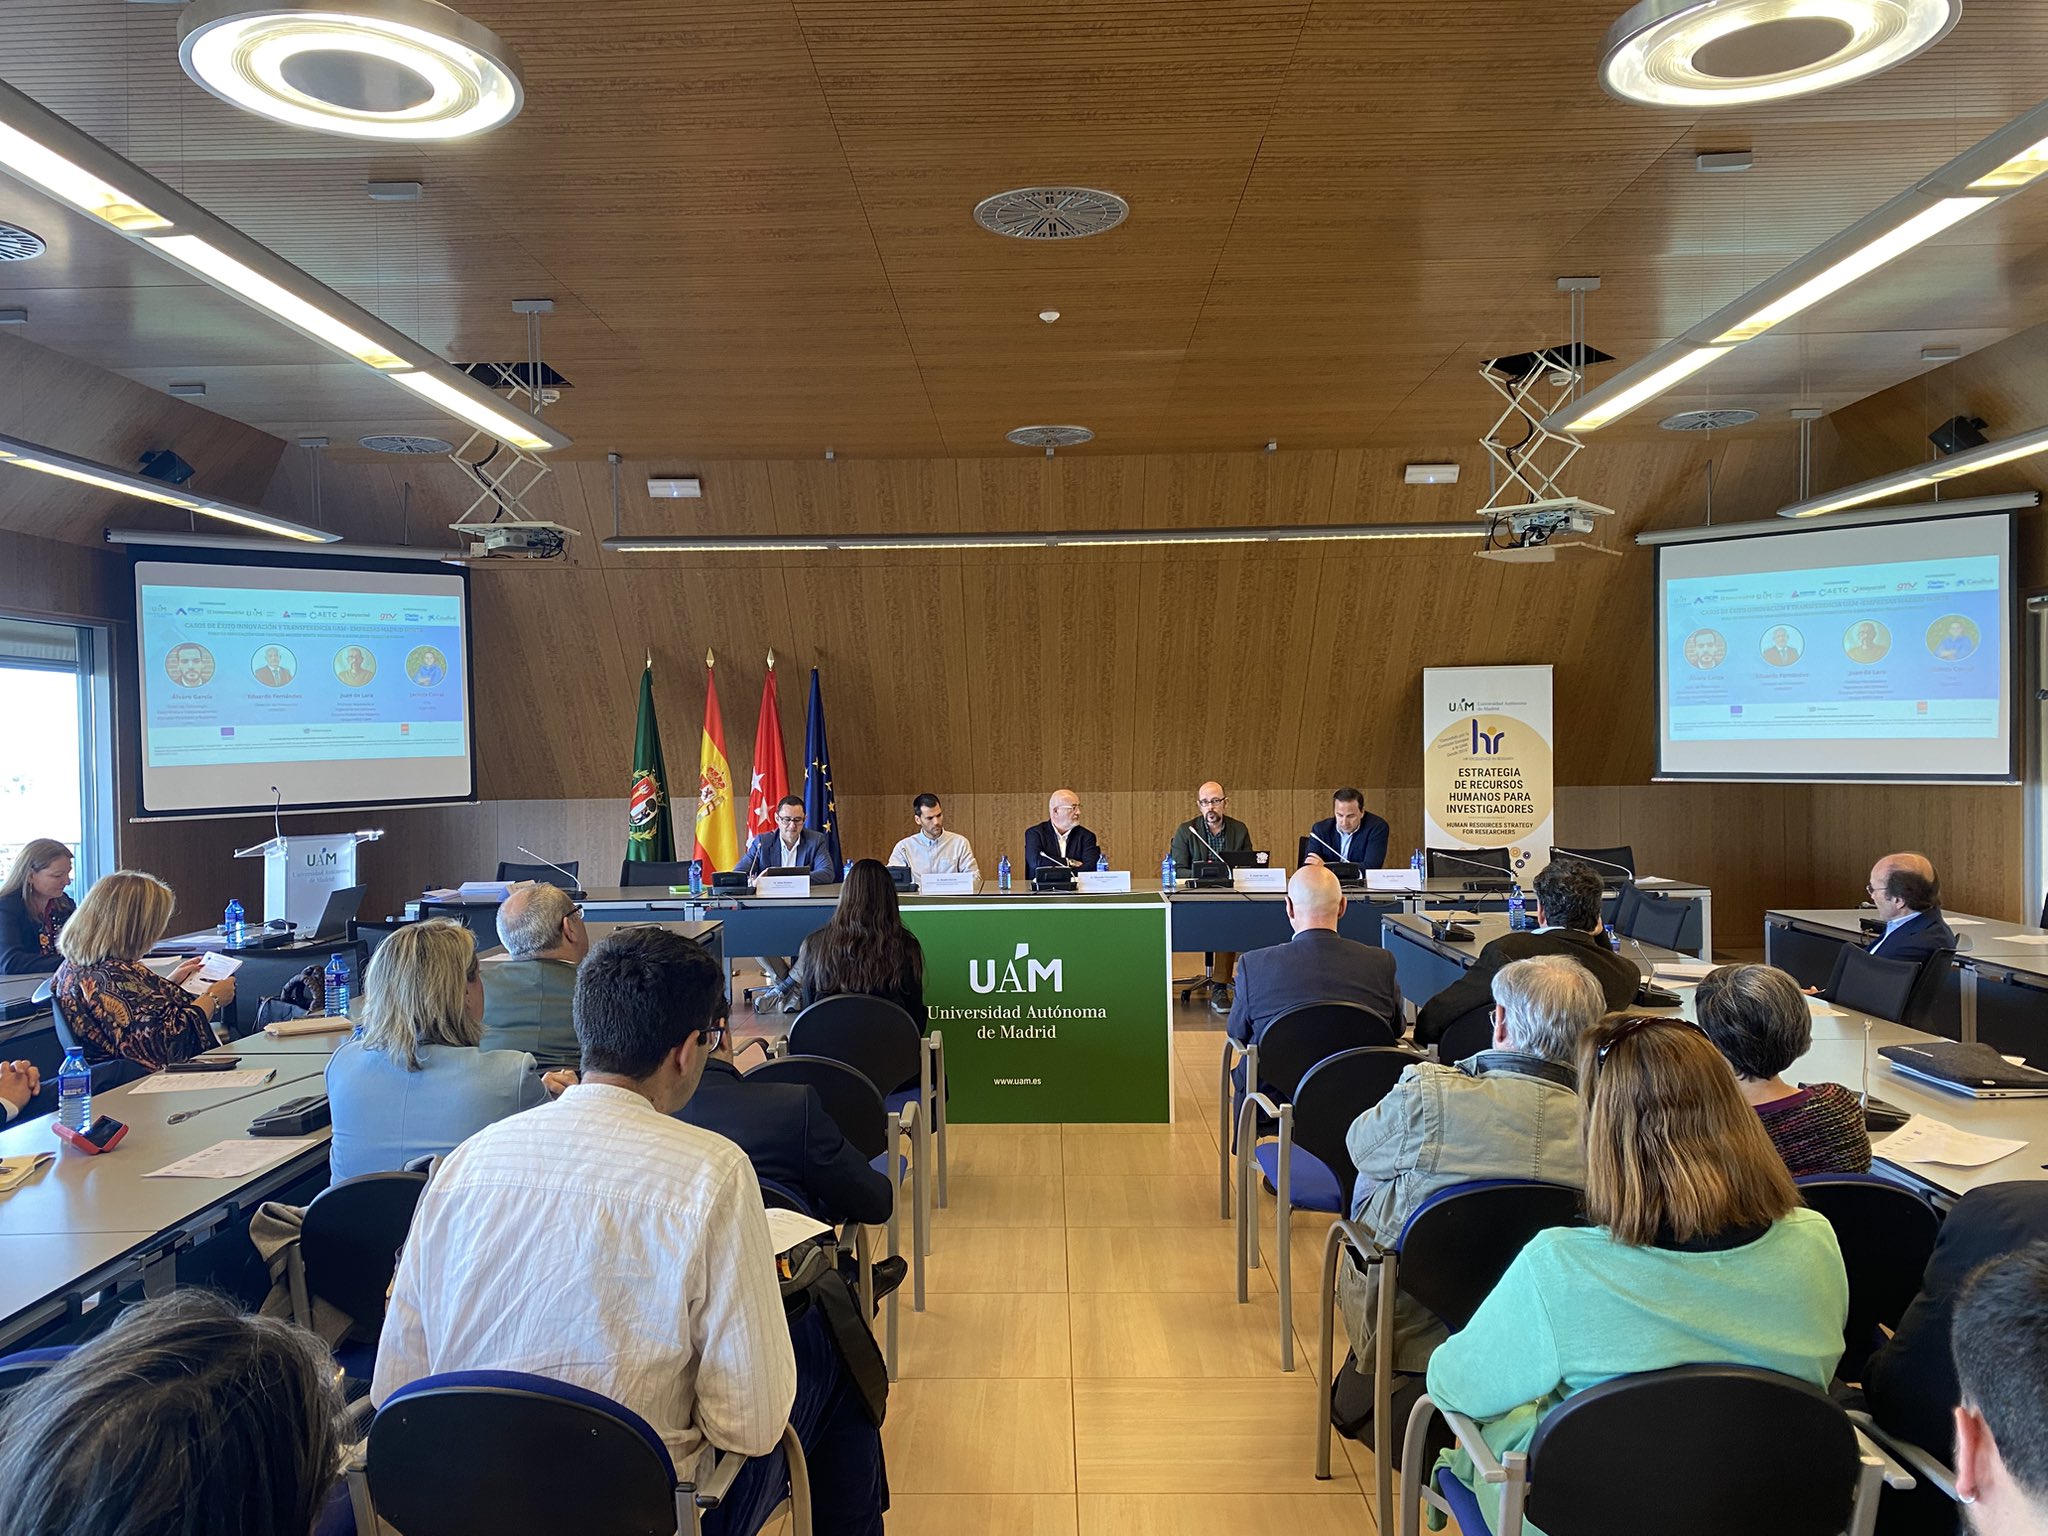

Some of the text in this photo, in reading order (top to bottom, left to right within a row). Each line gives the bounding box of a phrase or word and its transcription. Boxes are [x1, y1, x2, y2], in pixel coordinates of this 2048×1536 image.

[1458, 767, 1521, 777] ESTRATEGIA
[1454, 780, 1523, 789] DE RECURSOS
[1449, 792, 1531, 801] HUMANOS PARA
[1446, 804, 1534, 813] INVESTIGADORES
[927, 1005, 1107, 1020] Universidad Autónoma
[976, 1025, 1057, 1039] de Madrid
[993, 1077, 1042, 1086] www.uam.es
